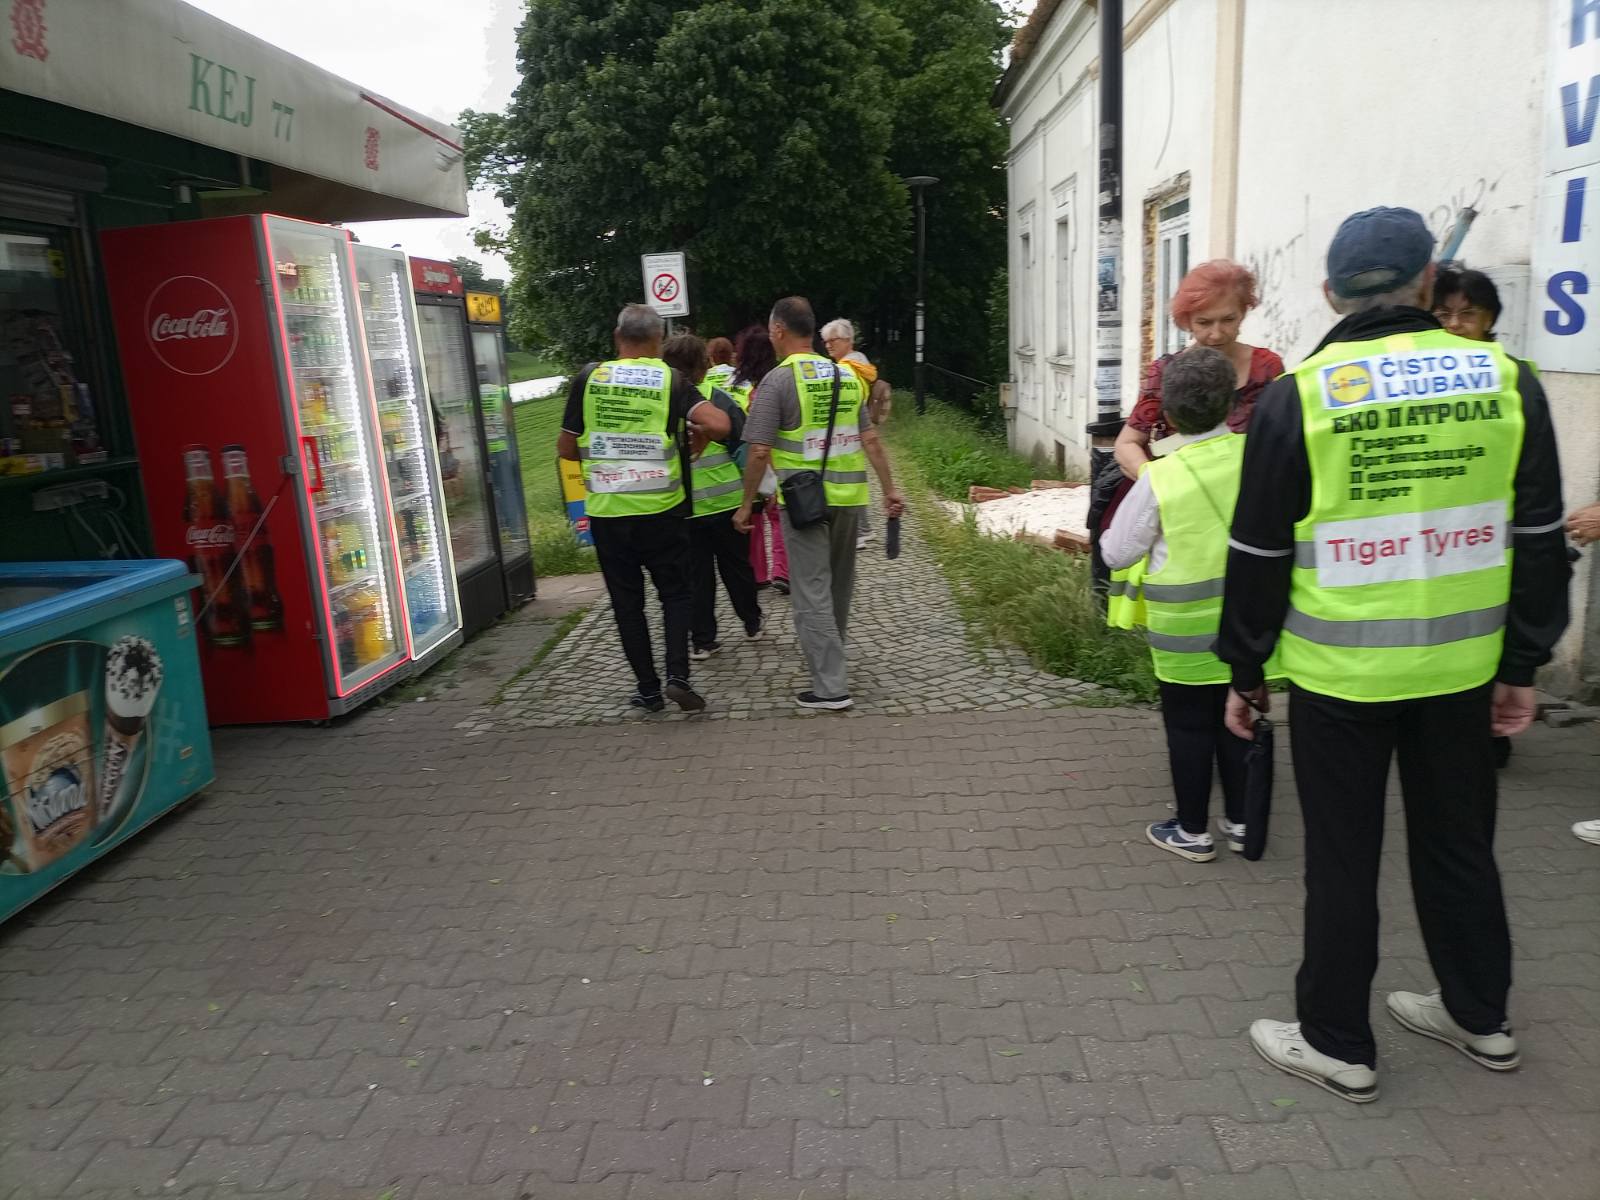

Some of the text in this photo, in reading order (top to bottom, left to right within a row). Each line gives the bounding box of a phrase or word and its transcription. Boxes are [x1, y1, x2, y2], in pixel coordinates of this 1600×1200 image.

[188, 53, 295, 142] KEJ 77
[1380, 355, 1458, 378] ČISTO
[1467, 355, 1492, 368] IZ
[1384, 372, 1493, 398] LJUBAVI
[1333, 400, 1503, 434] ЕКО ПАТРОЛА
[1326, 525, 1495, 565] Tigar Tyres
